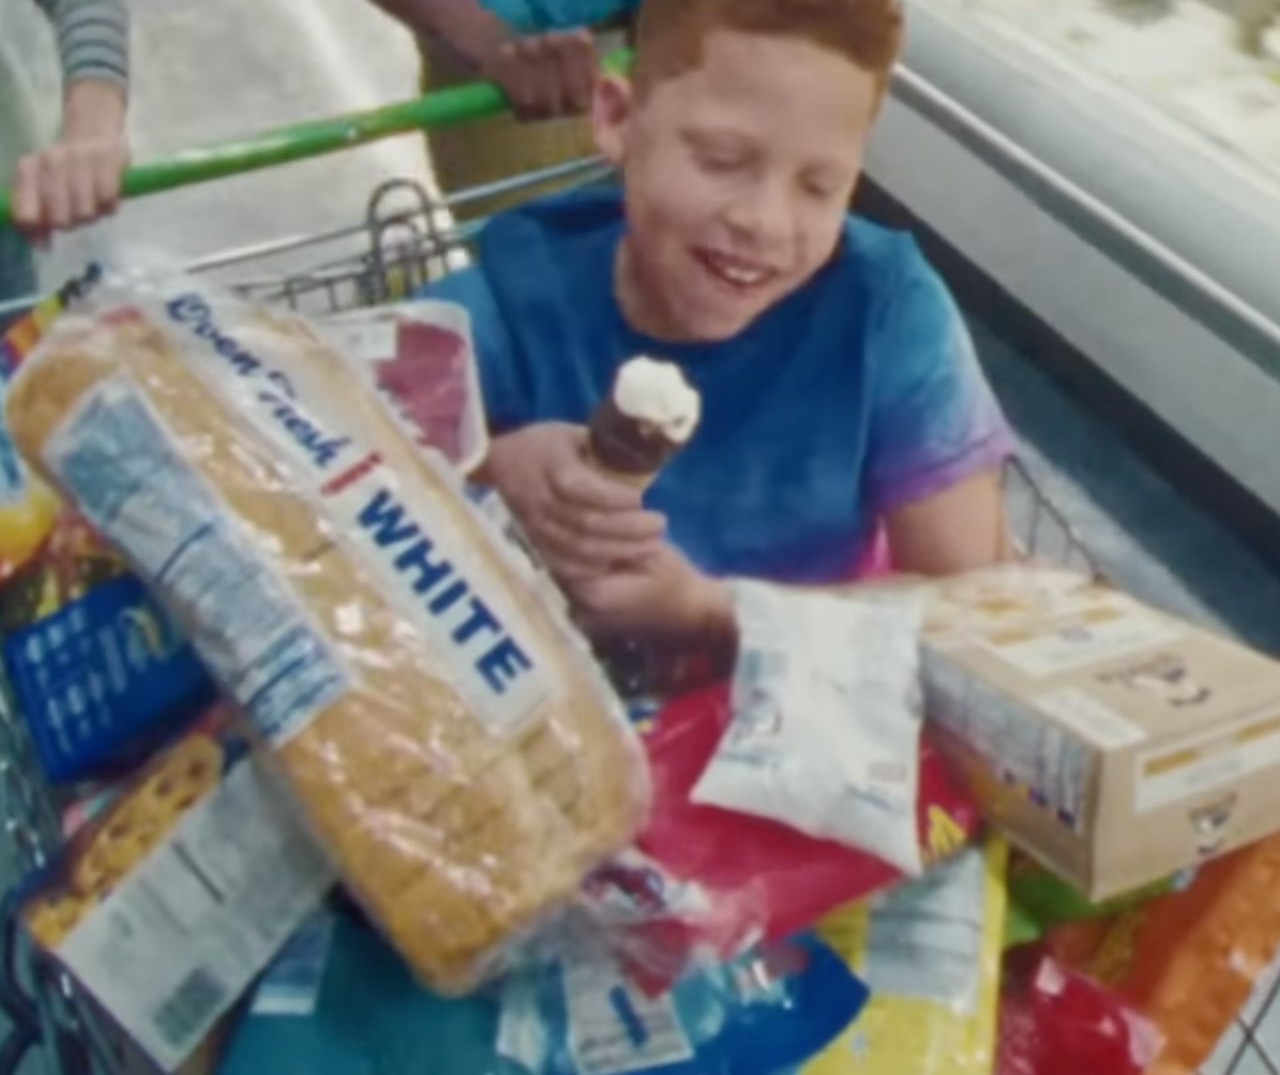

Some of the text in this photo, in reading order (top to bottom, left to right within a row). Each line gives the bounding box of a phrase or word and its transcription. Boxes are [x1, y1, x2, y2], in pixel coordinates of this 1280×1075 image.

[165, 291, 353, 469] Oven Fresh
[356, 487, 534, 695] WHITE
